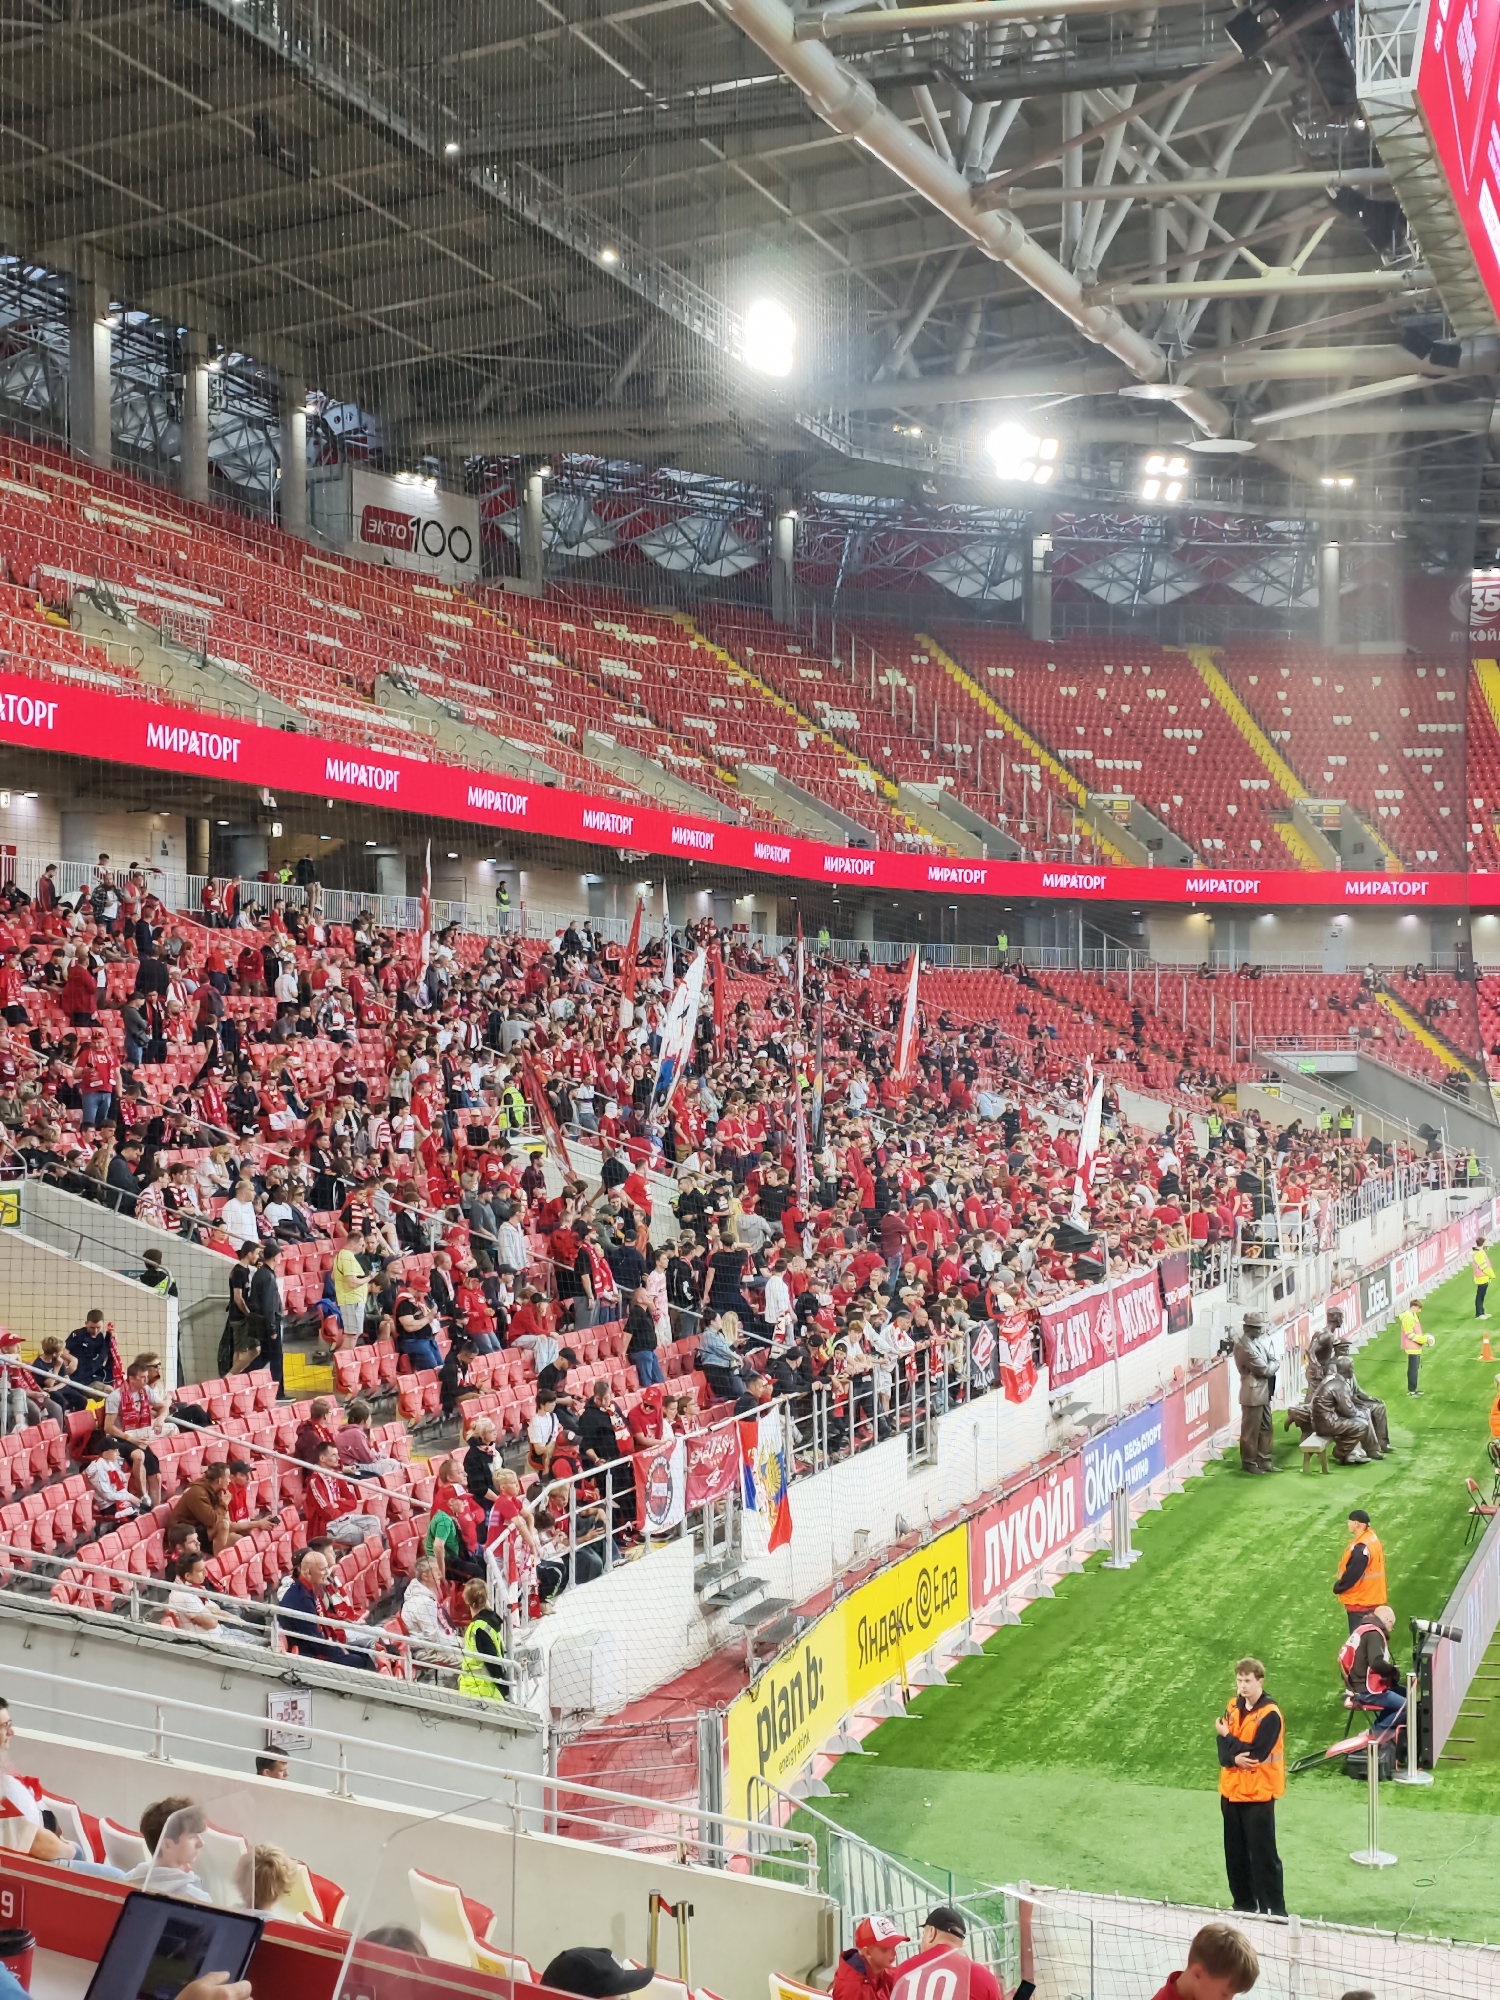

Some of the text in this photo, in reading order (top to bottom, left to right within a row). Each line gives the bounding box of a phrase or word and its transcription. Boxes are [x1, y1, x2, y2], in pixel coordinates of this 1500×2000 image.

[368, 516, 473, 564] ЭКТО 100
[146, 722, 241, 763] МИРАТОРГ
[325, 757, 400, 793] МИРАТОРГ
[467, 785, 529, 816] МИРАТОРГ
[582, 809, 634, 836] МИРАТОРГ
[671, 826, 715, 850] МИРАТОРГ
[754, 842, 791, 864] МИРАТОРГ
[823, 855, 876, 876] МИРАТОРГ
[927, 866, 988, 884] МИРАТОРГ
[1042, 872, 1107, 890] МИРАТОРГ
[1185, 877, 1261, 894] МИРАТОРГ
[1345, 881, 1430, 896] МИРАТОРГ
[1124, 1439, 1141, 1463] ВЕСЬ
[1140, 1423, 1162, 1452] СПОРТ
[1130, 1457, 1149, 1485] КИНО
[983, 1473, 1075, 1596] ЛУКОЙЛ
[857, 1565, 958, 1670] Яндекс Еда
[756, 1670, 805, 1785] plan
